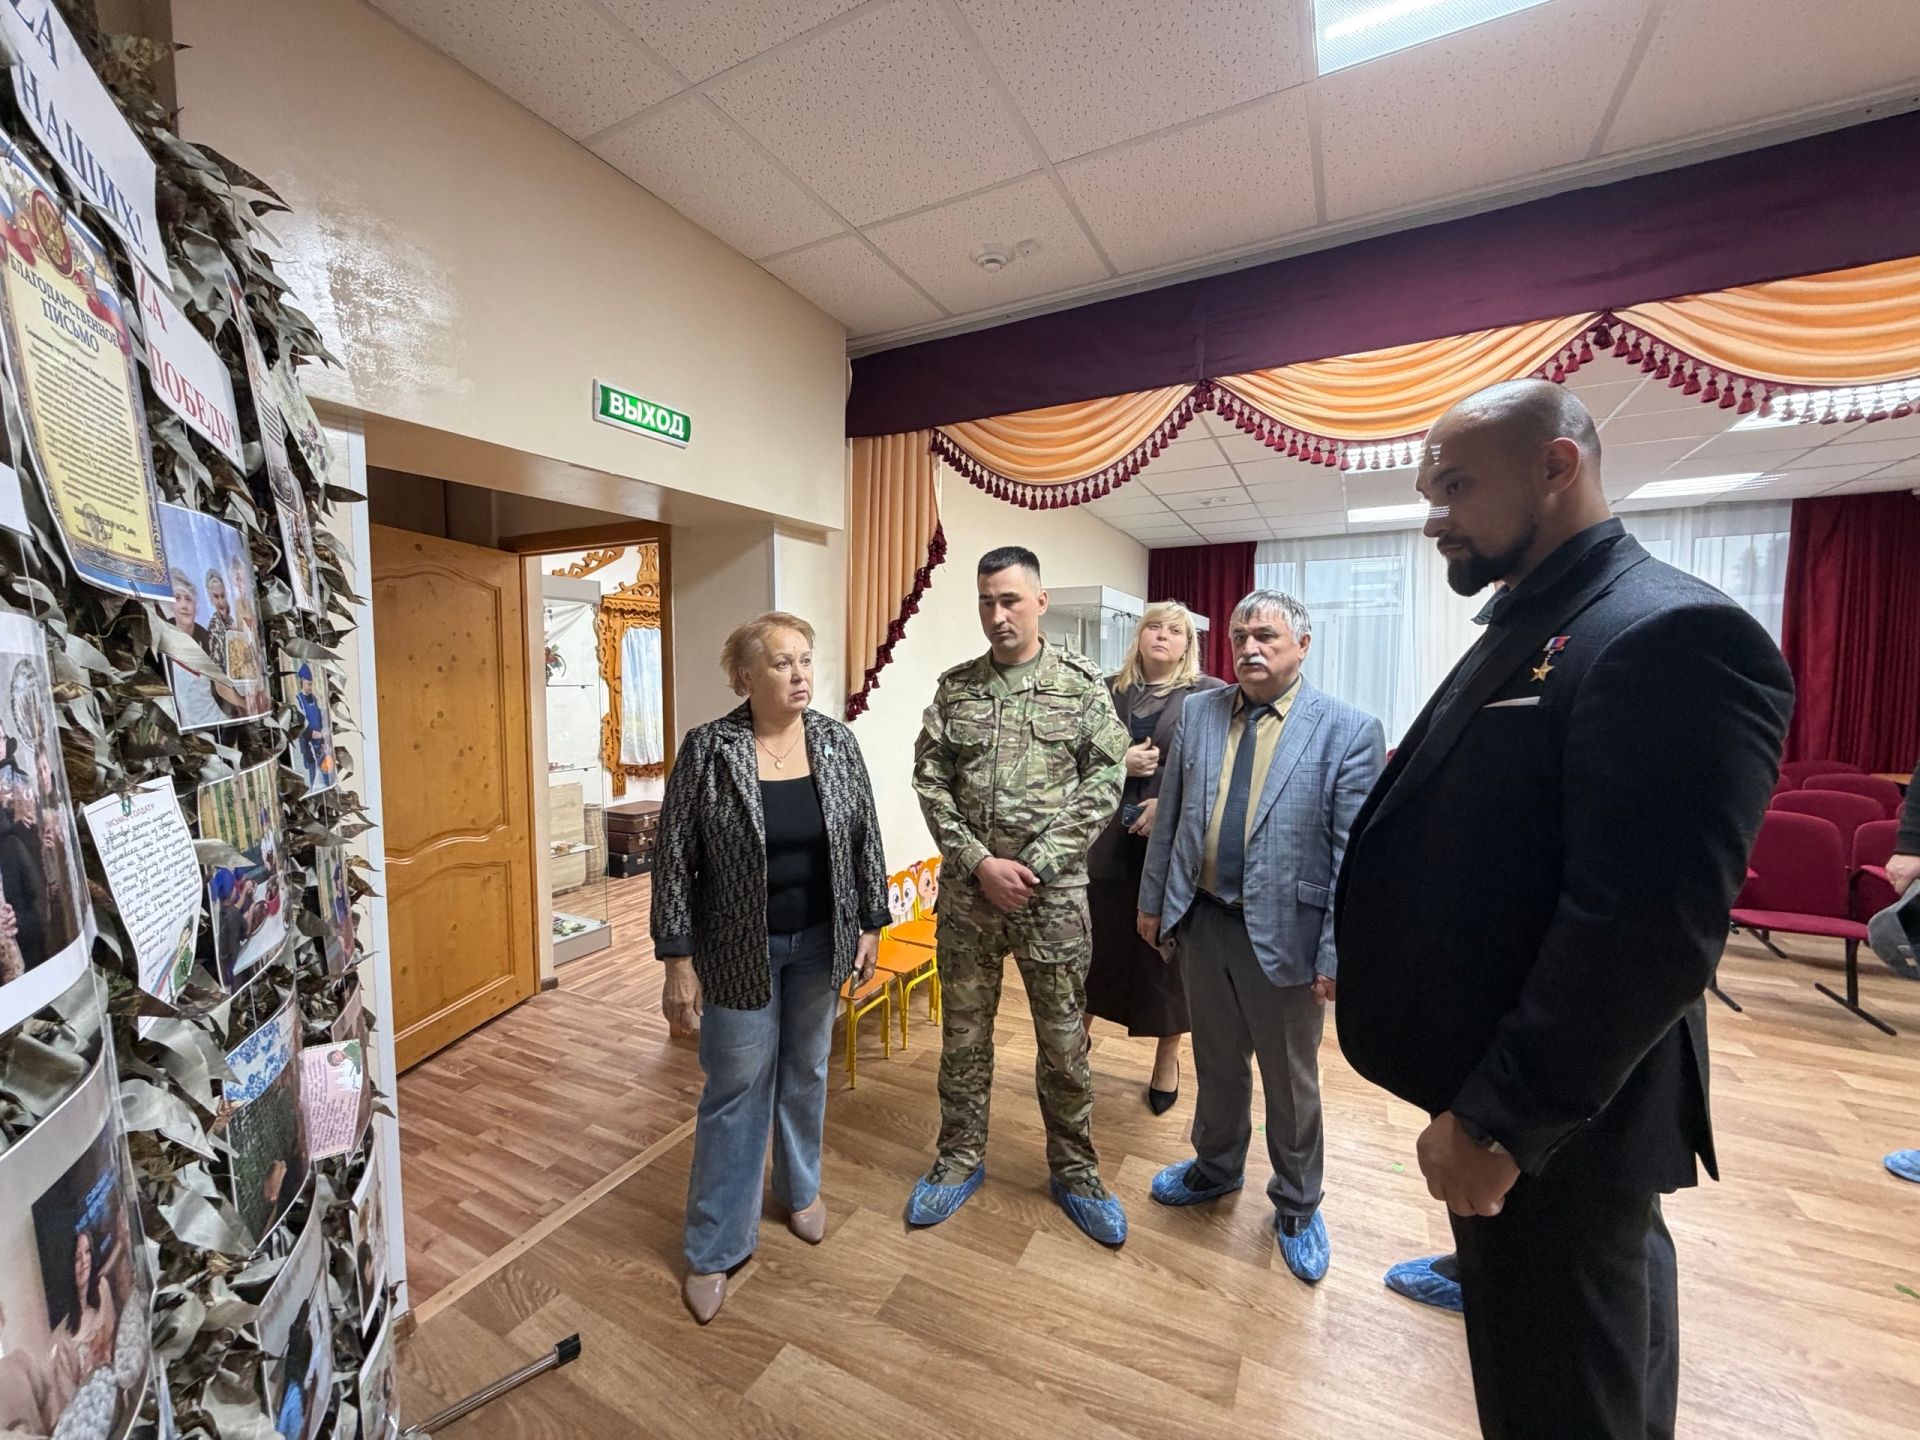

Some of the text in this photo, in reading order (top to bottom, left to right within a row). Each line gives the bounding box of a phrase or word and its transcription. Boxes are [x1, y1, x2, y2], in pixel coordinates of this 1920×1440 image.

[17, 52, 148, 255] НАШИХ!
[9, 253, 119, 347] БЛАГОДАРСТВЕННОЕ
[41, 298, 99, 353] ПИСЬМО
[609, 391, 685, 439] ВЫХОД
